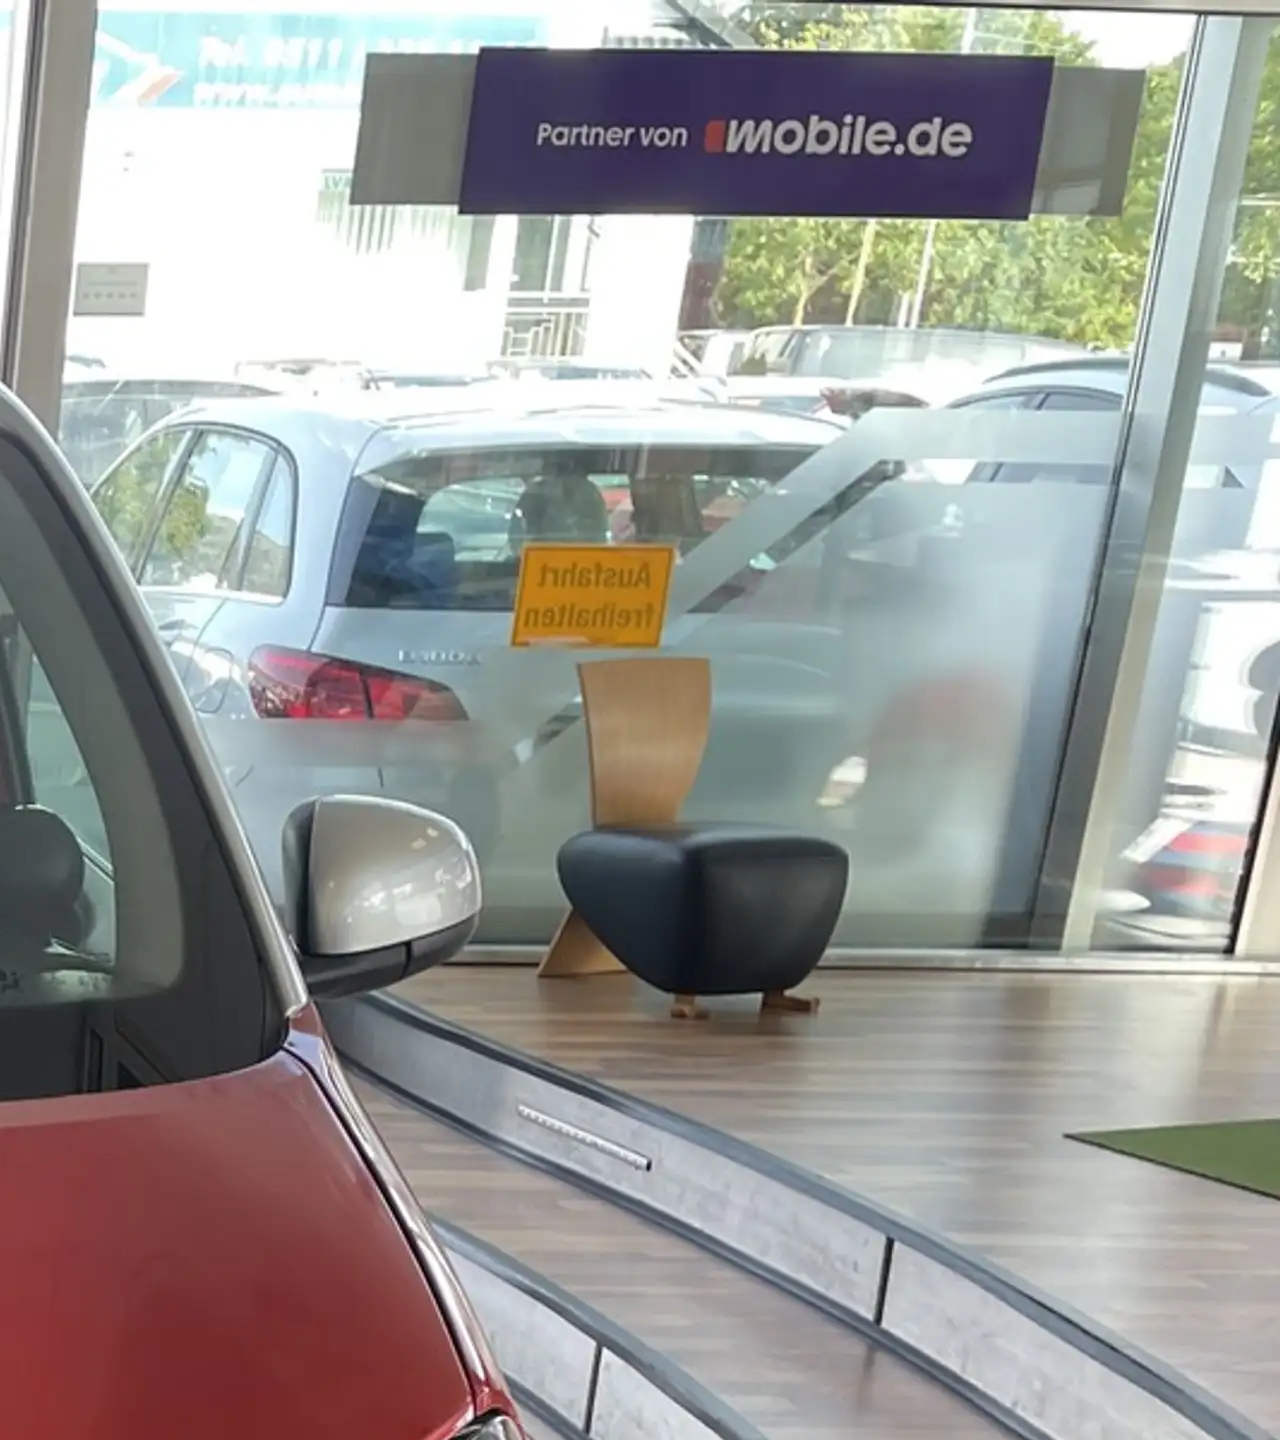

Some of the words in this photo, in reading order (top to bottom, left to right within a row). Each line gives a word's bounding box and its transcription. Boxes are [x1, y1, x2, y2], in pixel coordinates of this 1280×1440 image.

[536, 122, 635, 148] Partner
[640, 125, 688, 148] von
[725, 114, 974, 158] mobile.de
